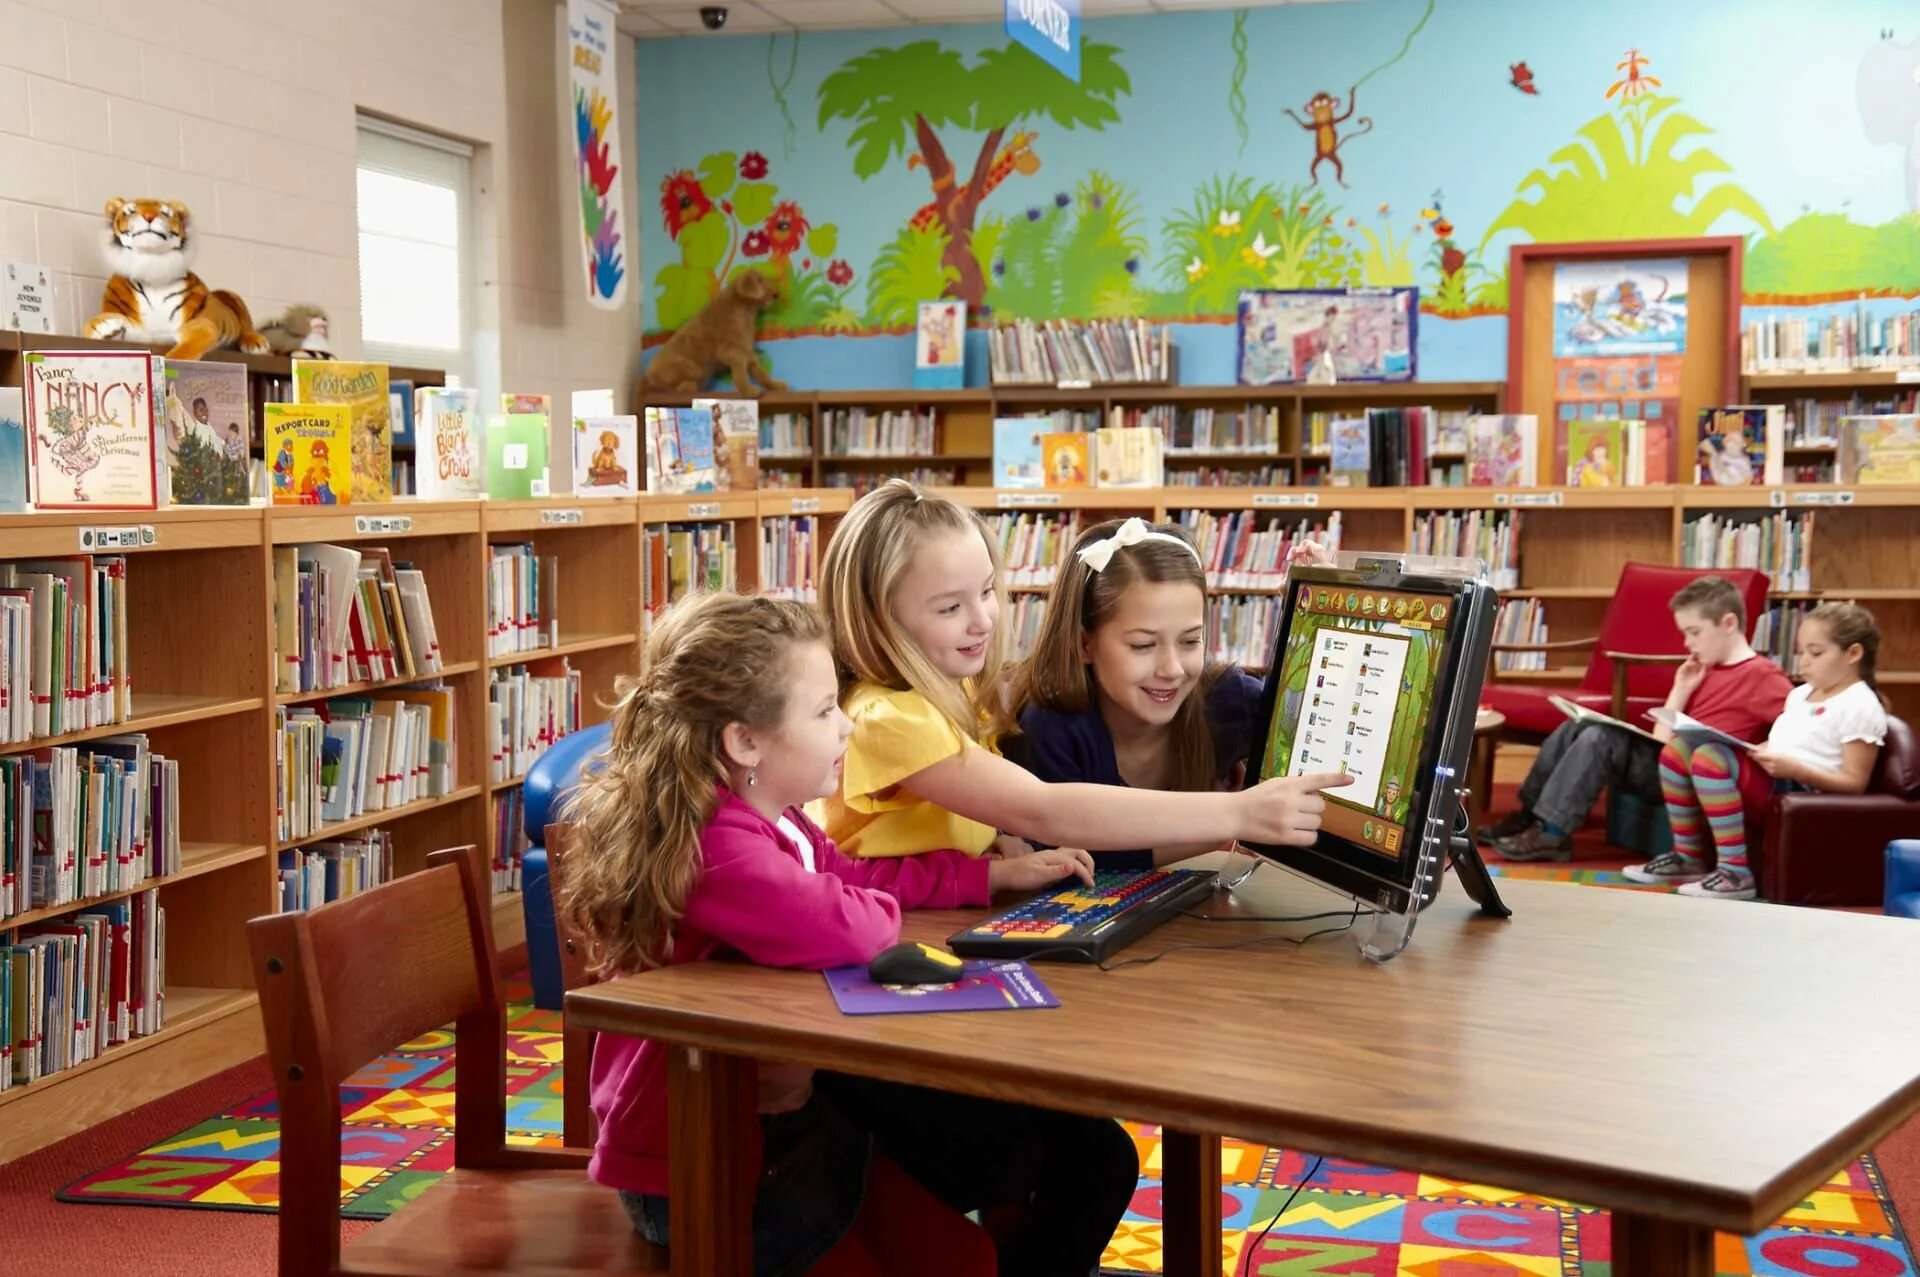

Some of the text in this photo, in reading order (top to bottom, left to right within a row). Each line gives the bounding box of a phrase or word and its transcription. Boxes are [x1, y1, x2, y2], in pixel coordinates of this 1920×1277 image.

[35, 366, 74, 382] Fancy
[311, 372, 338, 394] Good
[46, 379, 145, 428] NANCY
[274, 418, 331, 435] REPORT CARD
[437, 410, 464, 432] Little
[436, 431, 468, 457] Black
[439, 456, 471, 480] Crow
